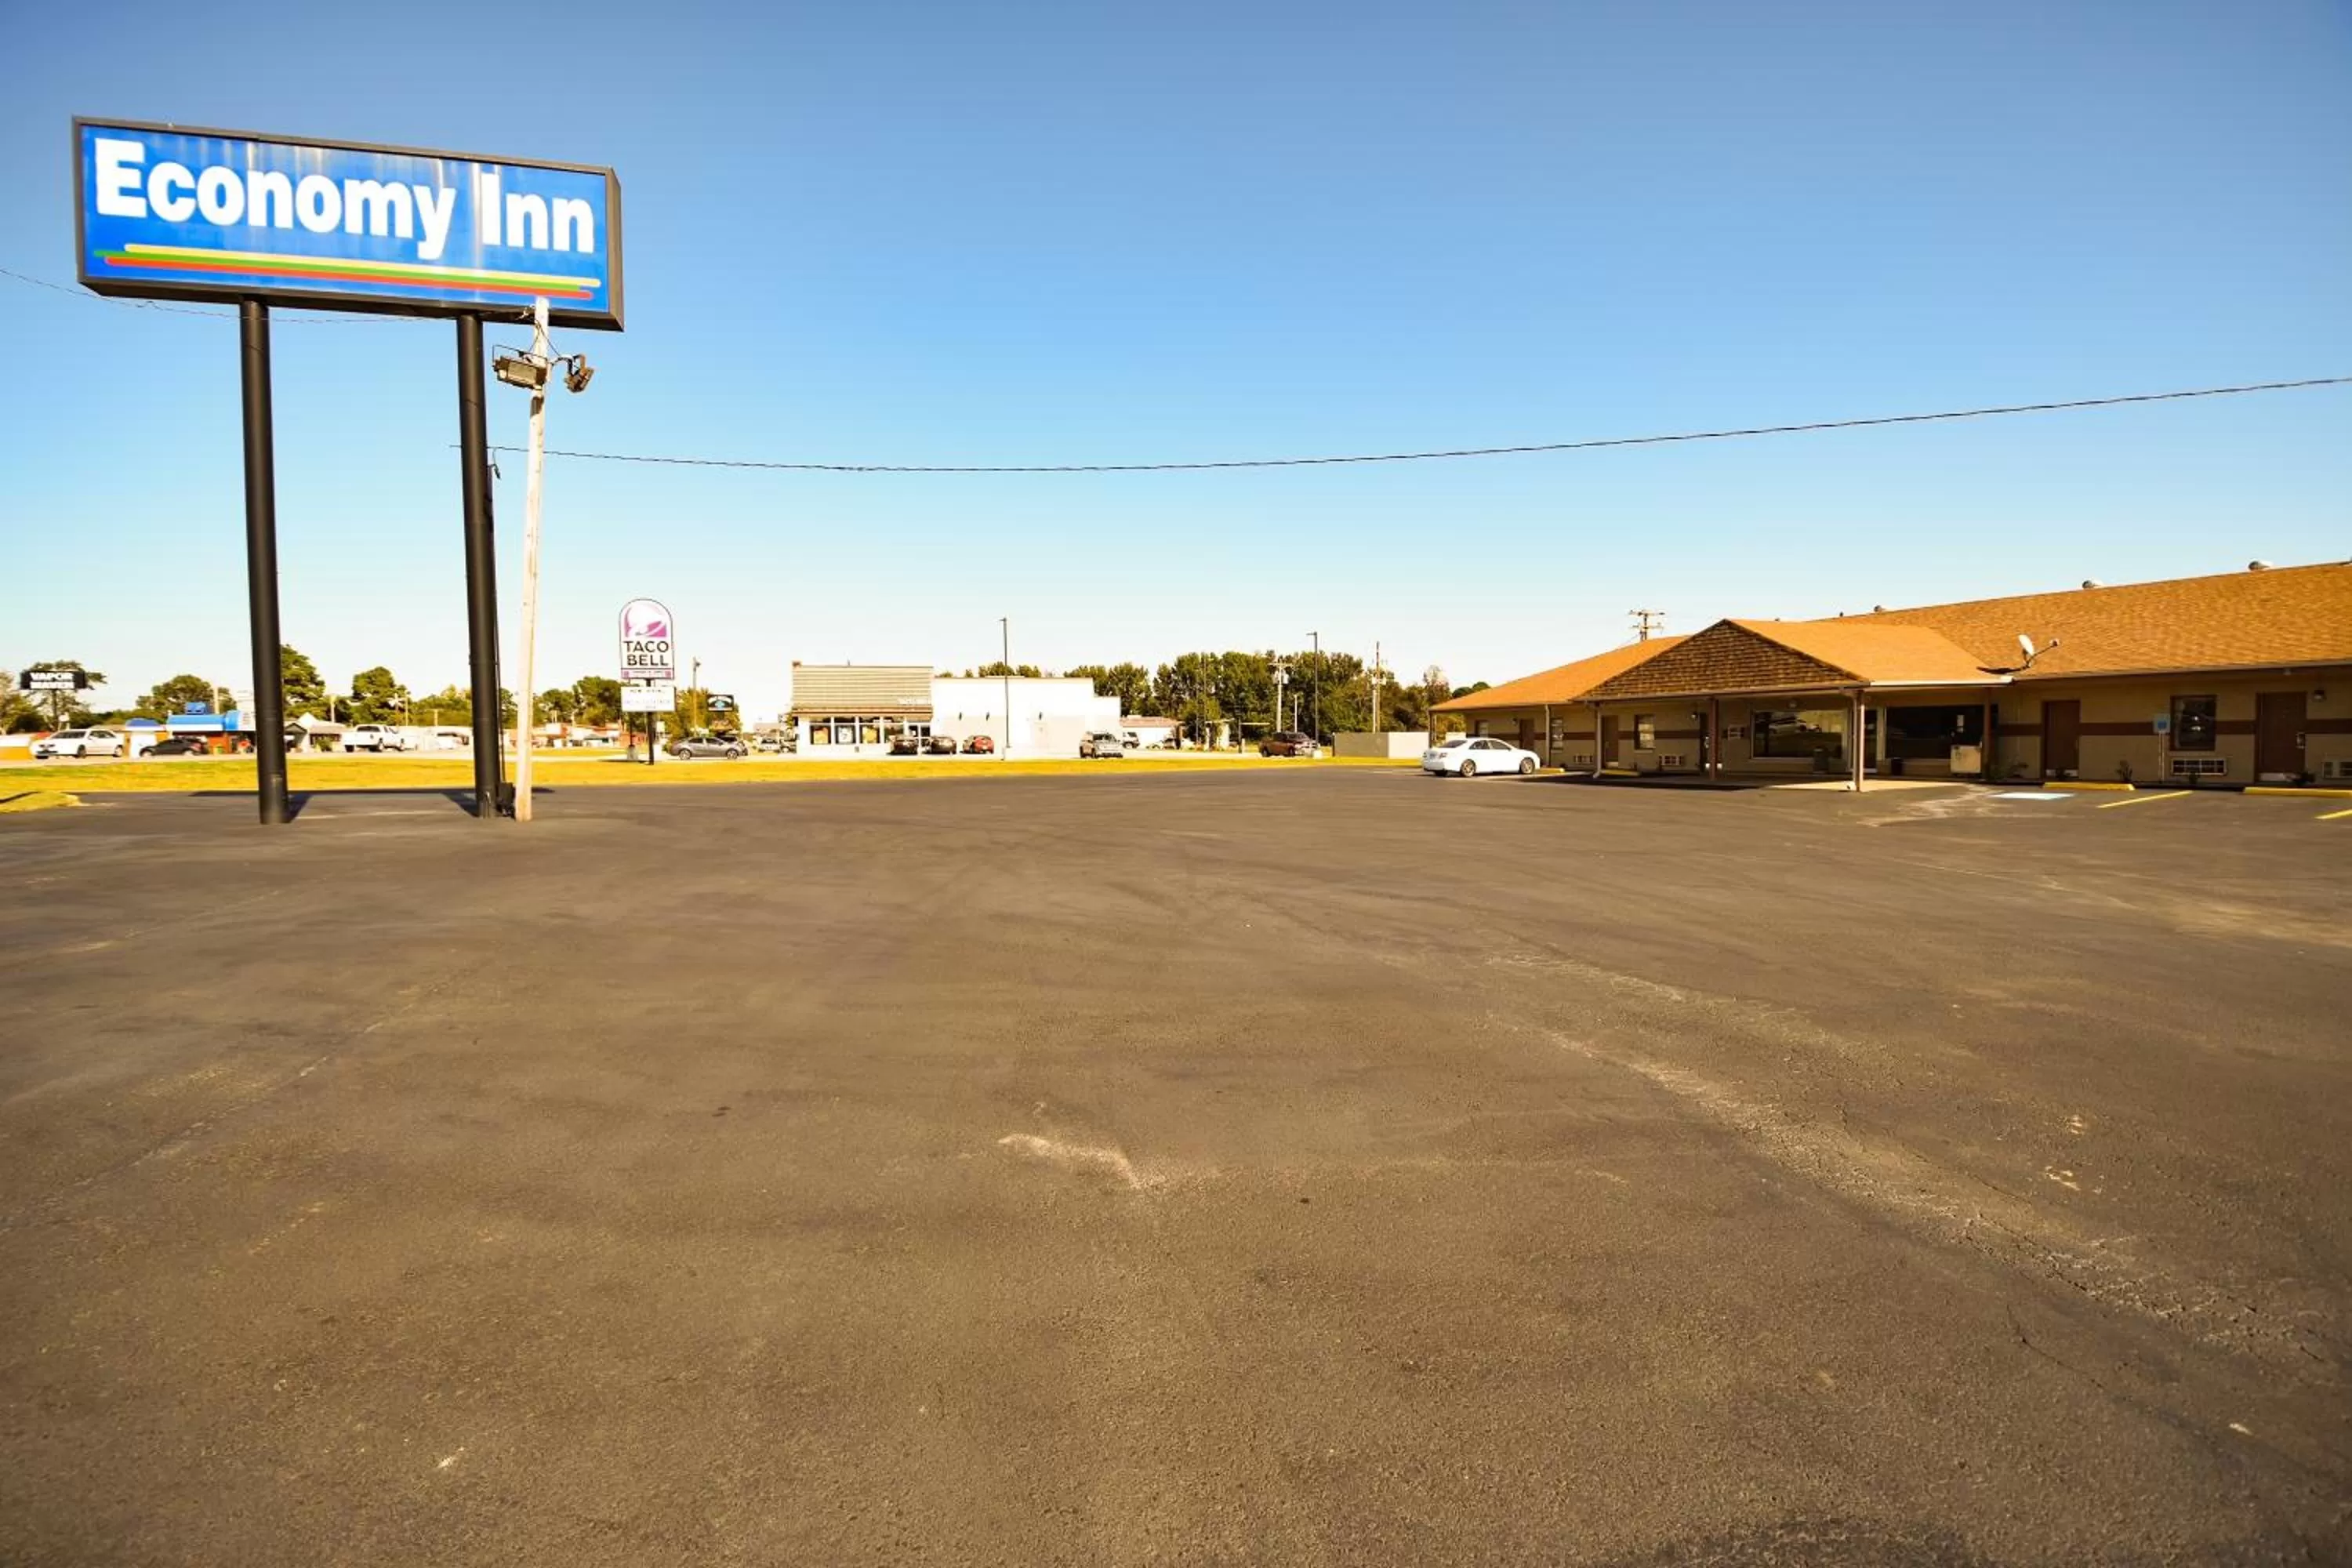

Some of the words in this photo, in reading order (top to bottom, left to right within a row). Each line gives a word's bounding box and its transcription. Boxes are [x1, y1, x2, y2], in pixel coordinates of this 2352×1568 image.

[96, 137, 456, 260] Economy
[480, 171, 595, 254] Inn
[623, 641, 669, 652] TACO
[627, 654, 669, 666] BELL
[30, 672, 74, 681] VAPOR
